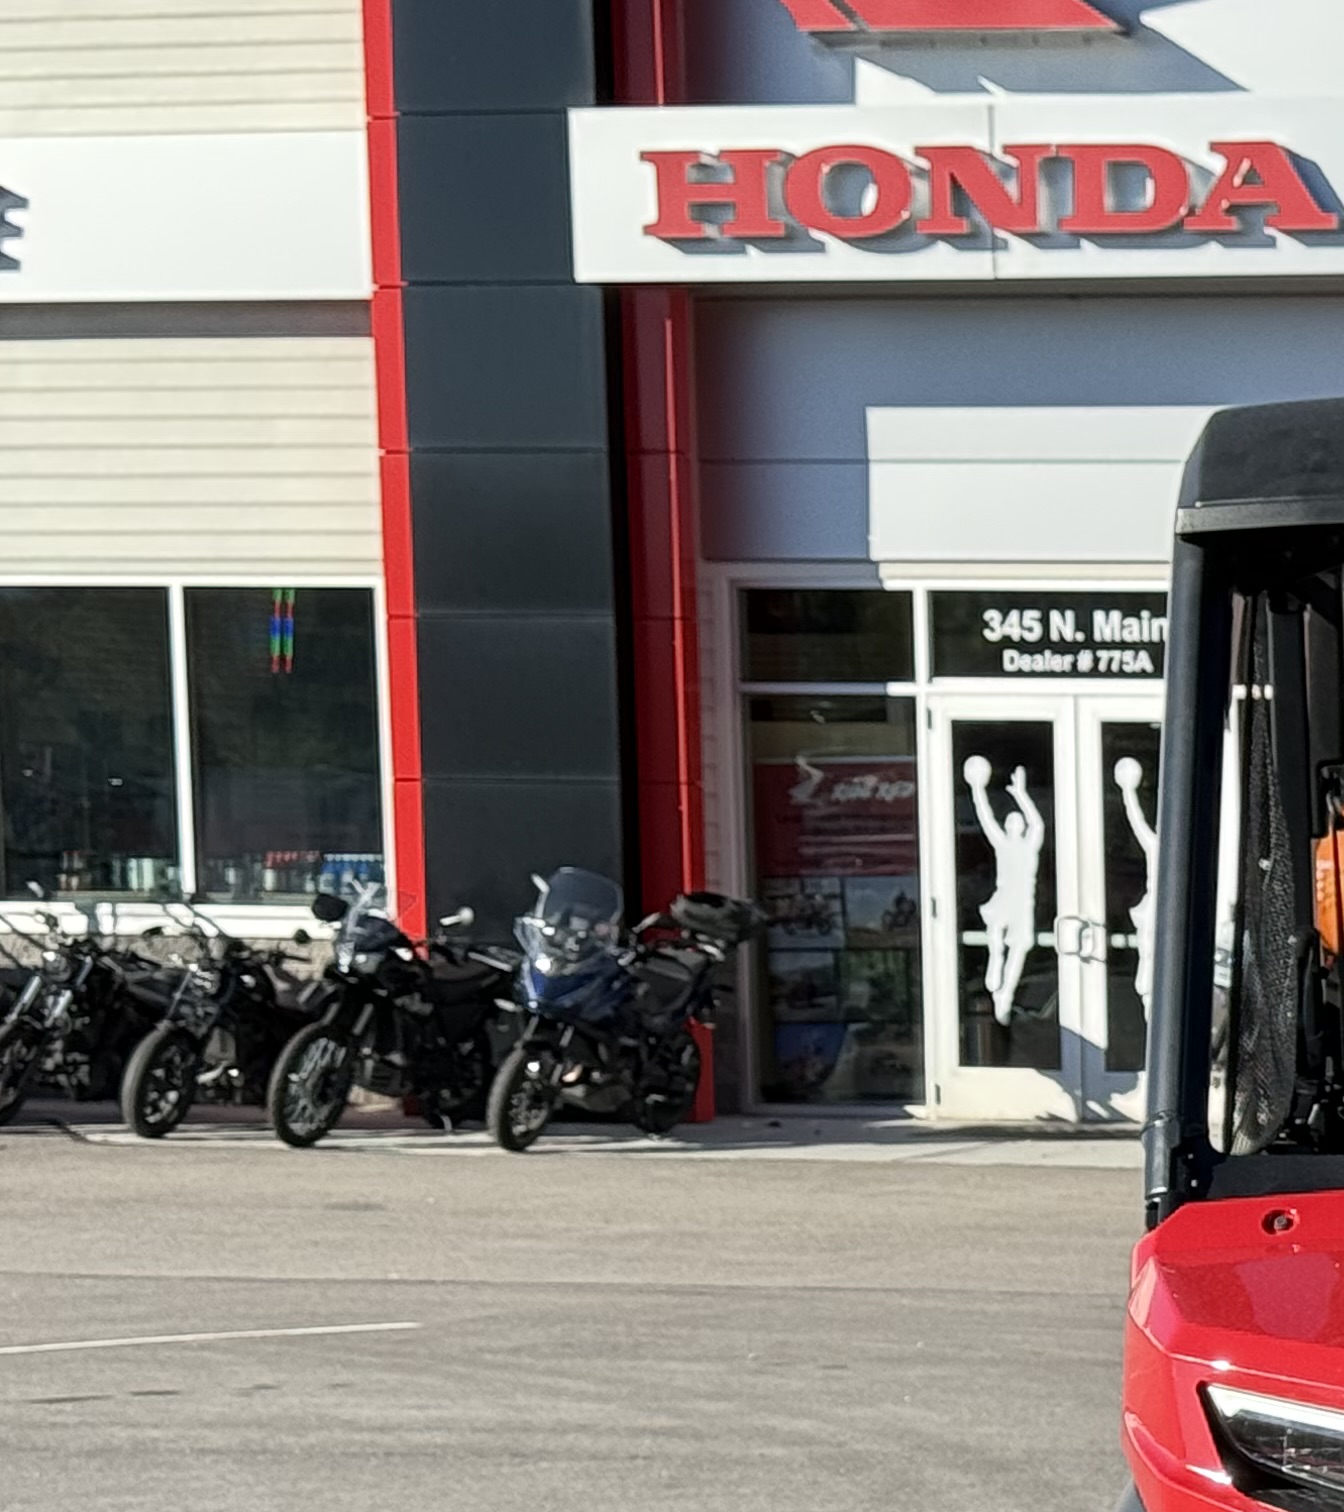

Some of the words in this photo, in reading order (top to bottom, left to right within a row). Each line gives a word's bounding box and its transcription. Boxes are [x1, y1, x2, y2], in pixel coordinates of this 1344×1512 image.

[640, 141, 1340, 238] HONDA
[981, 608, 1044, 643] 345
[1048, 609, 1086, 643] N.
[1092, 609, 1169, 643] Main
[1002, 648, 1075, 673] Dealer
[1076, 648, 1094, 673] #
[1095, 648, 1155, 674] 775A
